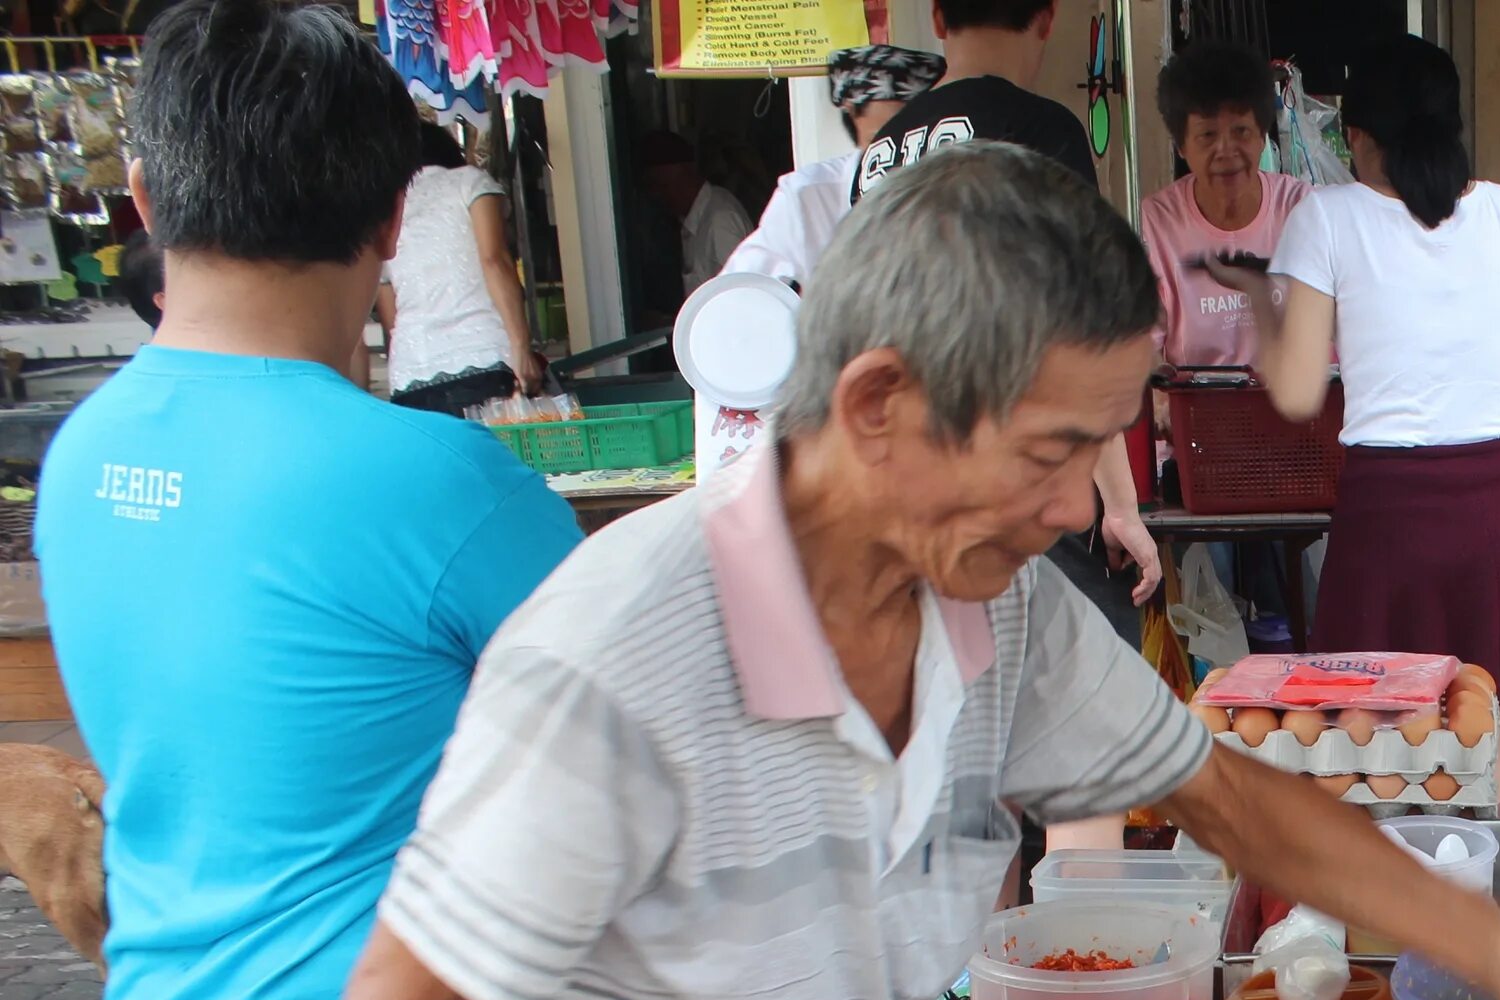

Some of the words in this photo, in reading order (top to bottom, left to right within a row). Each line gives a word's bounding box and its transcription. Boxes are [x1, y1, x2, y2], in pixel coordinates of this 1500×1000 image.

[730, 3, 789, 12] Menstrual
[792, 1, 820, 9] Pain
[740, 12, 778, 21] Vessel
[744, 22, 785, 30] Cancer
[704, 32, 751, 41] Slimming
[754, 30, 792, 39] (Burns
[794, 28, 817, 36] Fat)
[704, 41, 727, 50] Cold
[730, 40, 759, 49] Hand
[773, 39, 800, 47] Cold
[803, 37, 830, 45] Feet
[703, 50, 747, 59] Remove
[750, 49, 778, 58] Body
[780, 48, 816, 56] Winds
[702, 59, 762, 67] Eliminates
[765, 57, 797, 65] Aging
[95, 463, 183, 508] JEANS
